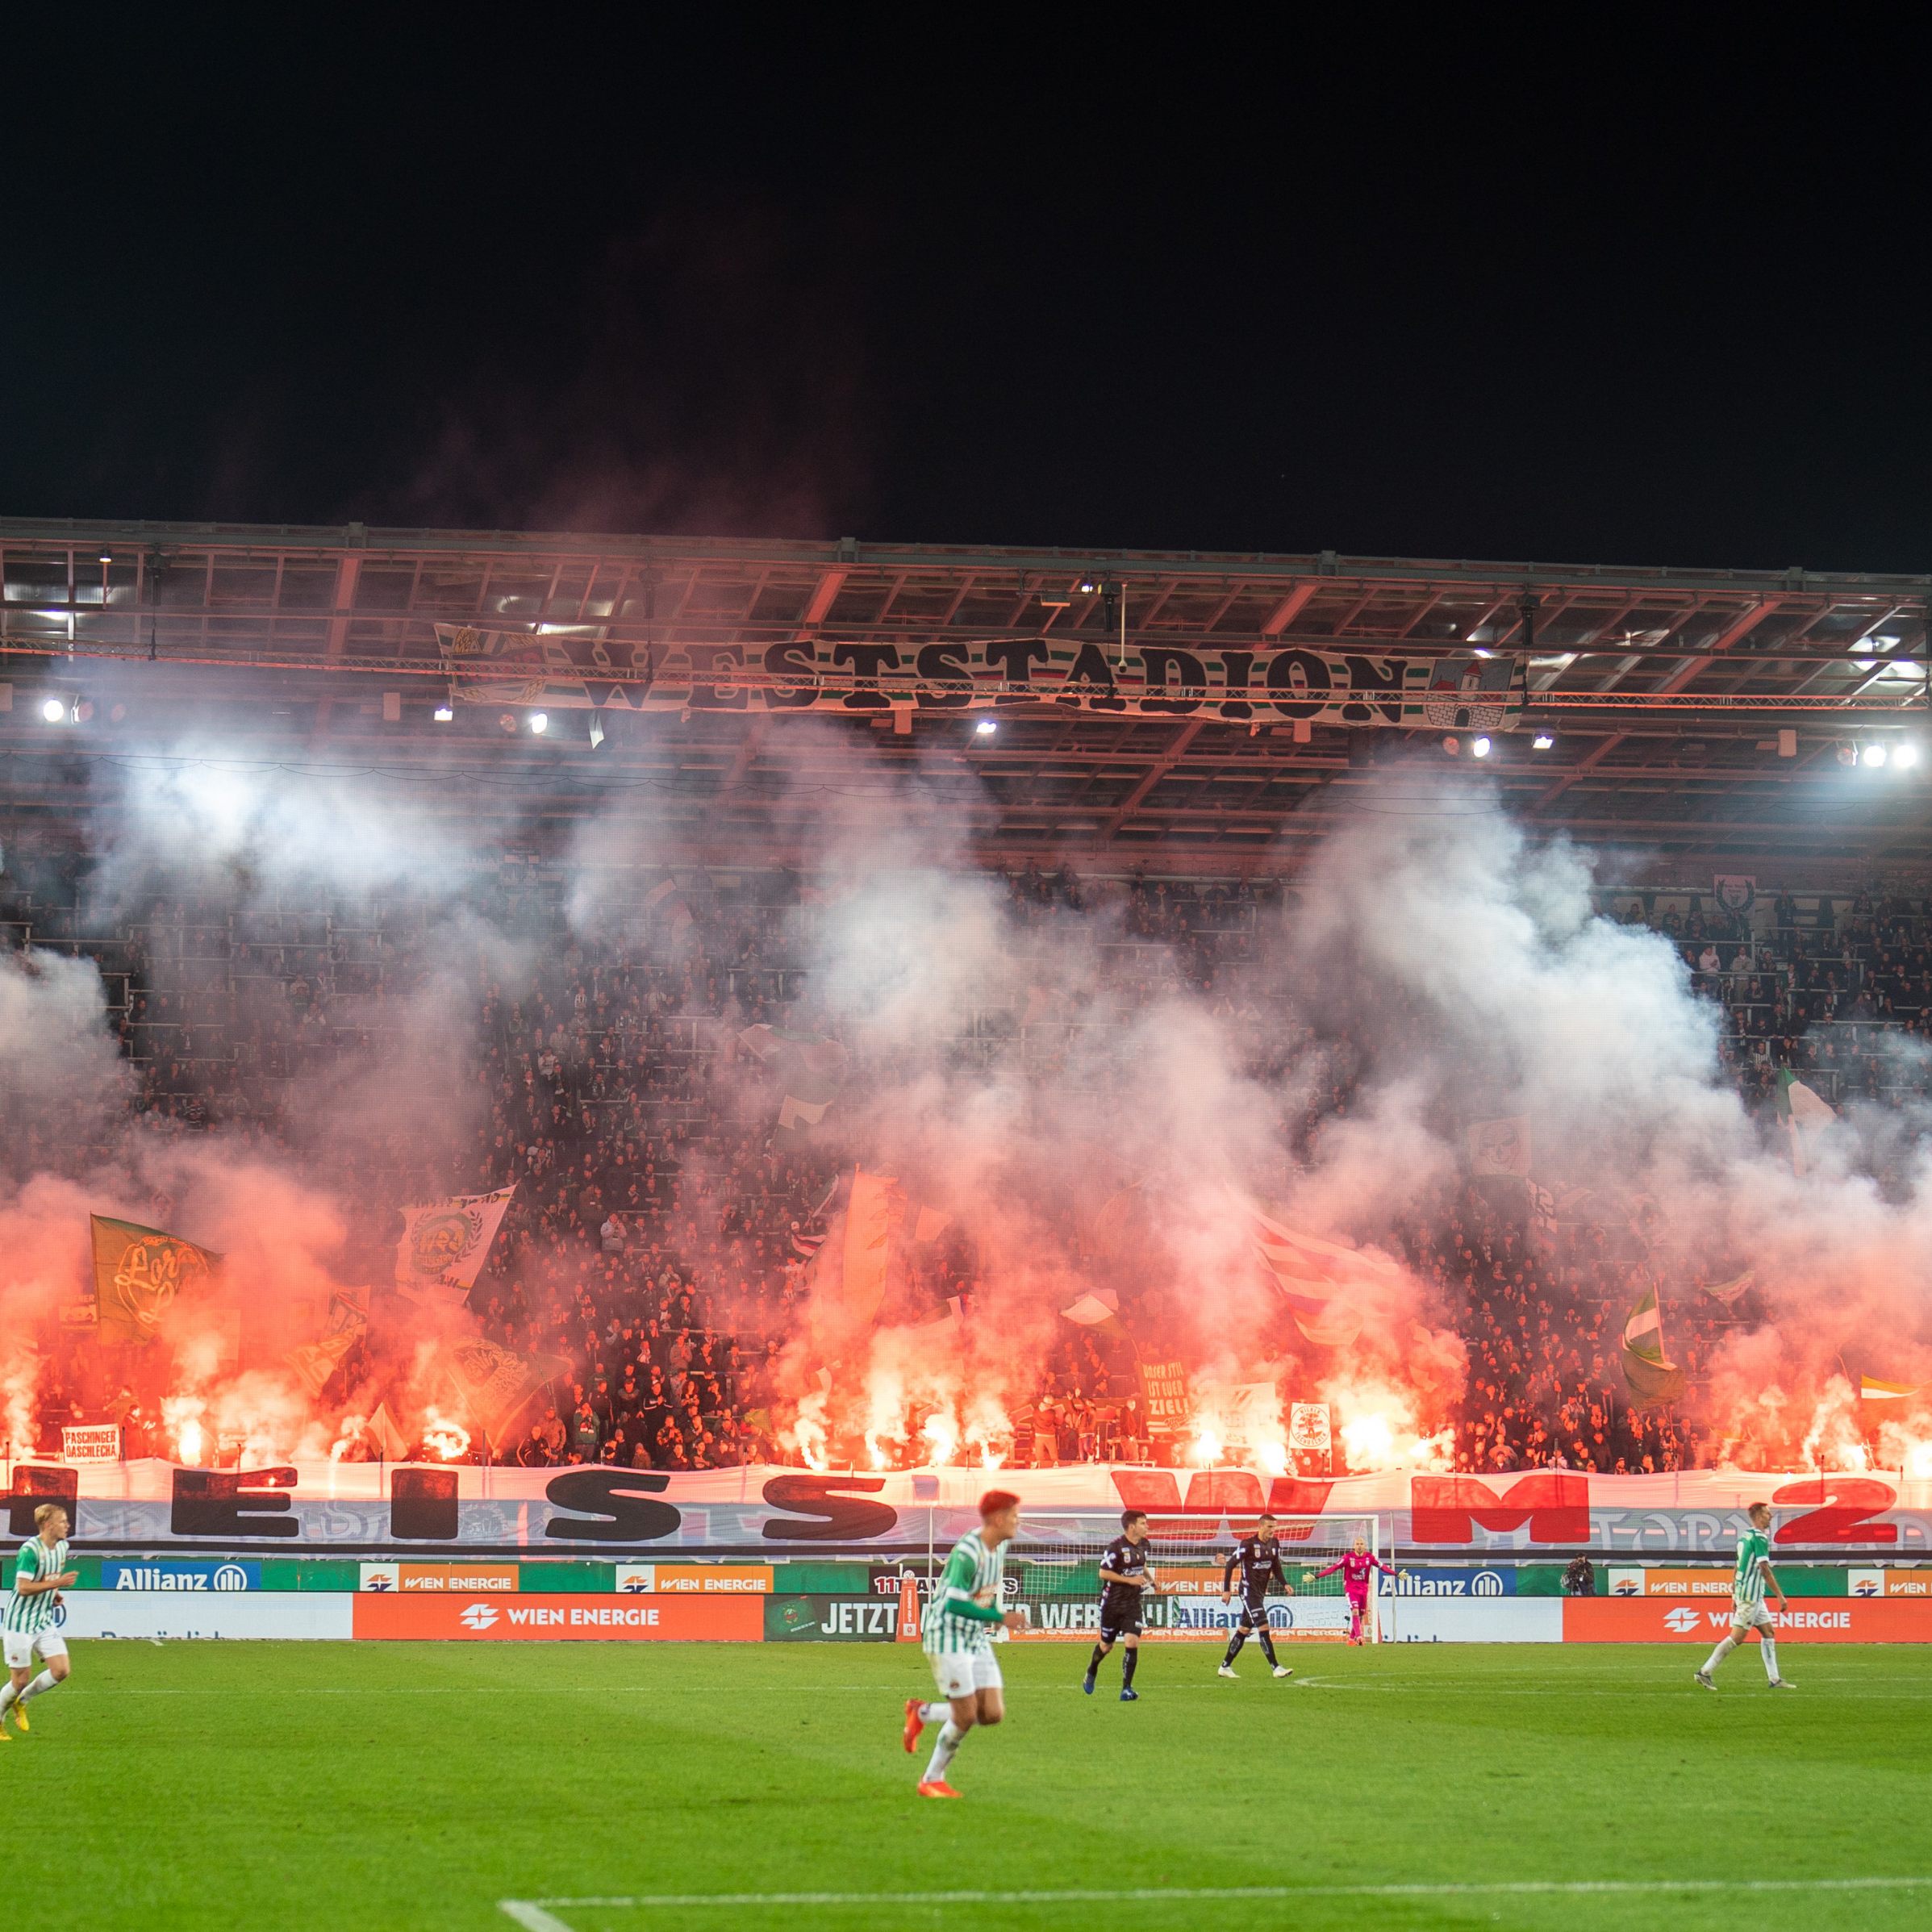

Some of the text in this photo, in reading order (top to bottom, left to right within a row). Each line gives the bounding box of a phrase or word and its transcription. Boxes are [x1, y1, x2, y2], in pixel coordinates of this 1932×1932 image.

[561, 638, 1408, 722] WESTSTADION
[1149, 1398, 1189, 1415] ZIEL!
[65, 1430, 116, 1444] PASCHINGER
[116, 1568, 208, 1590] Allianz
[405, 1577, 511, 1589] WIEN ENERGIE
[661, 1579, 766, 1591] WIEN ENERGIE
[1162, 1580, 1199, 1592] WIEN
[1379, 1574, 1466, 1596] Allianz
[1650, 1582, 1688, 1593] WIEN
[1890, 1582, 1926, 1594] WIEN
[507, 1609, 660, 1625] WIEN ENERGIE
[821, 1603, 898, 1634] JETZT
[1178, 1607, 1242, 1628] Allian
